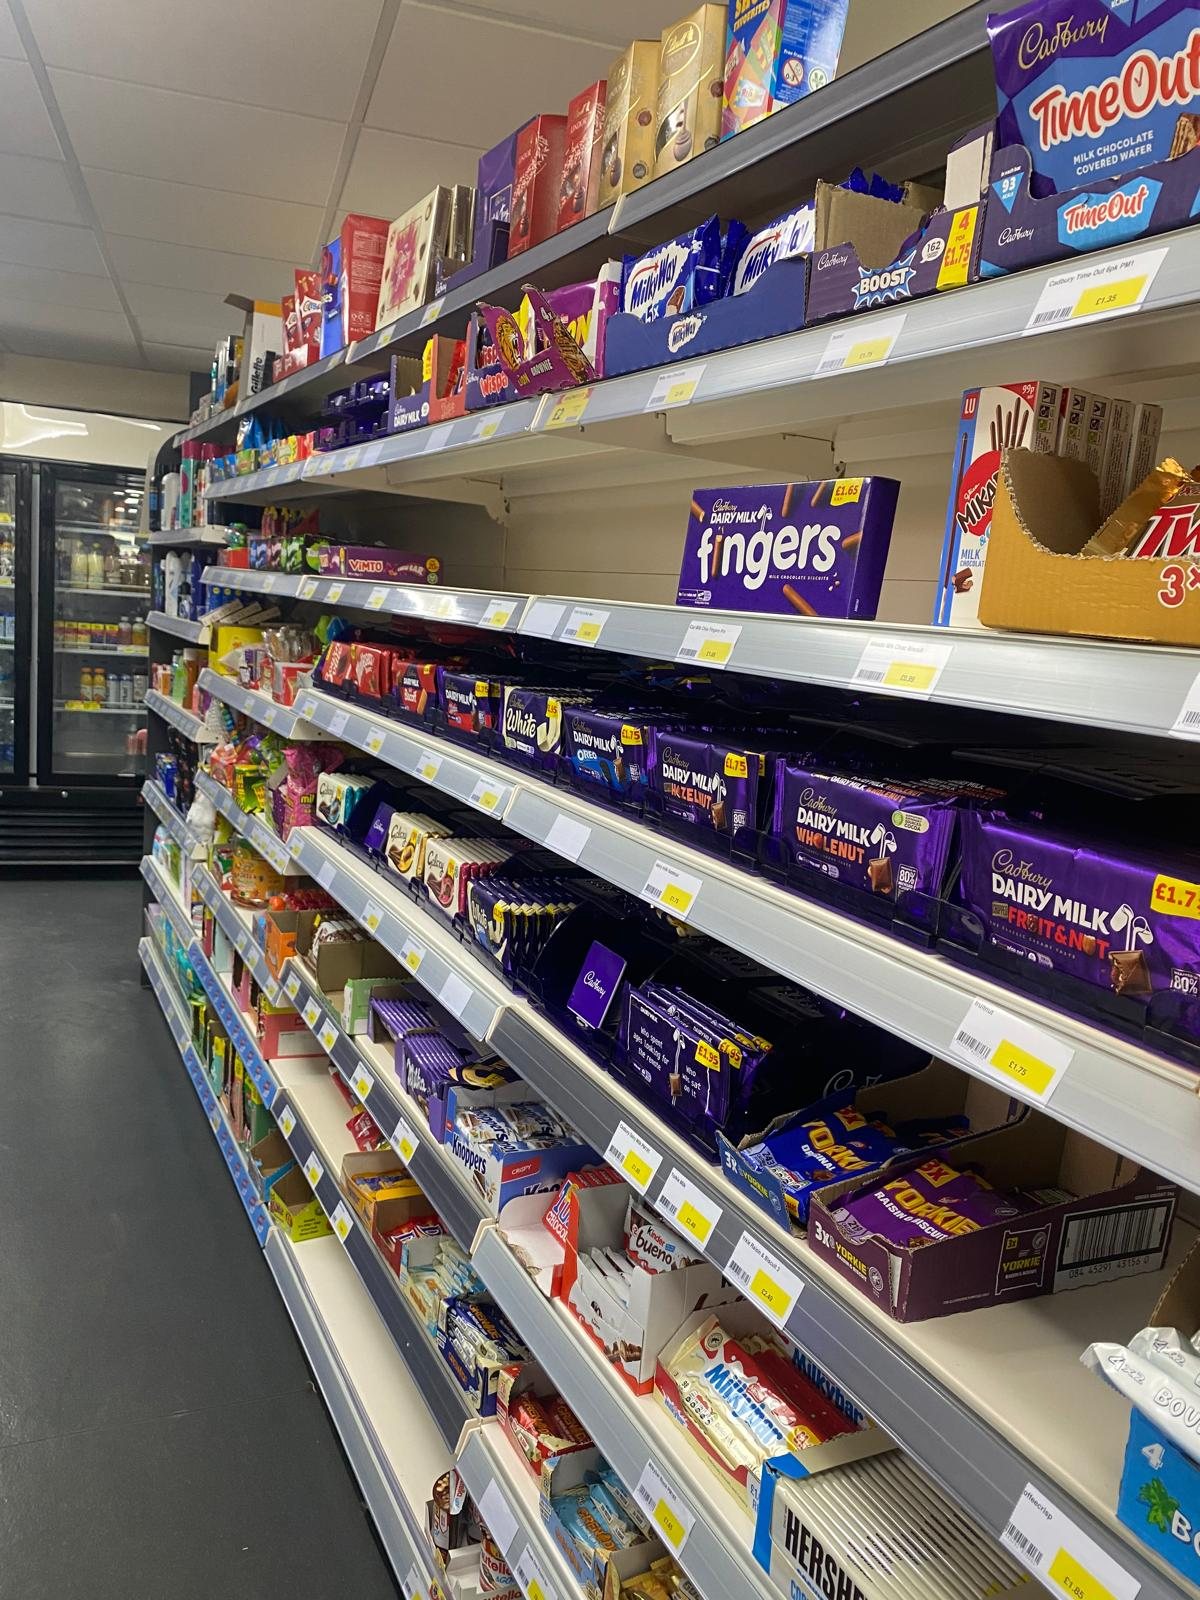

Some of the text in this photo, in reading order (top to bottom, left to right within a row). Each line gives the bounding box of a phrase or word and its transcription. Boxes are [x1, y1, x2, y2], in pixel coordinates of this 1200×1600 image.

[1017, 14, 1110, 71] Cadbury
[1073, 130, 1154, 166] MILK CHOCOLATE
[1076, 143, 1153, 176] COVERED WAFER
[1002, 178, 1016, 193] 93
[958, 211, 970, 230] 4
[1064, 184, 1149, 234] TimeOut
[927, 241, 941, 252] 162
[944, 243, 971, 267] £1.75
[817, 252, 848, 271] Cadbury
[860, 267, 909, 295] BOOST
[1076, 271, 1092, 281] Time
[1093, 267, 1105, 277] Out
[480, 371, 508, 397] Wispa
[1022, 384, 1035, 394] 99p
[964, 397, 976, 415] LU
[835, 485, 858, 496] £1.65
[710, 510, 757, 524] DAIRY MILK
[712, 498, 738, 513] Cadbury
[697, 523, 842, 590] fingers
[960, 559, 986, 568] CHOCOLAT
[961, 548, 980, 561] MILK
[506, 708, 537, 739] White
[573, 730, 611, 752] DAIRY MILK
[577, 749, 597, 761] OREO
[725, 755, 747, 774] £1.75
[662, 763, 713, 793] DAIRY MILK
[799, 788, 838, 819] Cadbury
[796, 807, 871, 848] DAIRY MILK
[899, 869, 915, 884] 80%
[991, 849, 1052, 893] Cadbury
[992, 872, 1110, 935] DAIRY MILK
[583, 970, 606, 999] Cadbury
[1173, 977, 1199, 995] 80%
[698, 1045, 719, 1066] £1.95
[1008, 1060, 1027, 1077] £1.75
[690, 1079, 702, 1091] sat
[452, 1132, 487, 1175] Knoppers
[874, 1190, 906, 1220] RAISIN
[884, 1178, 983, 1237] YORKIE
[635, 1230, 673, 1266] bueno
[646, 1225, 666, 1247] Kinder
[835, 1242, 869, 1277] YORKIE
[1002, 1255, 1041, 1272] YORKIE
[792, 1347, 863, 1425] Milkybar
[704, 1363, 784, 1445] Milkybar
[1063, 1576, 1085, 1600] £1.85
